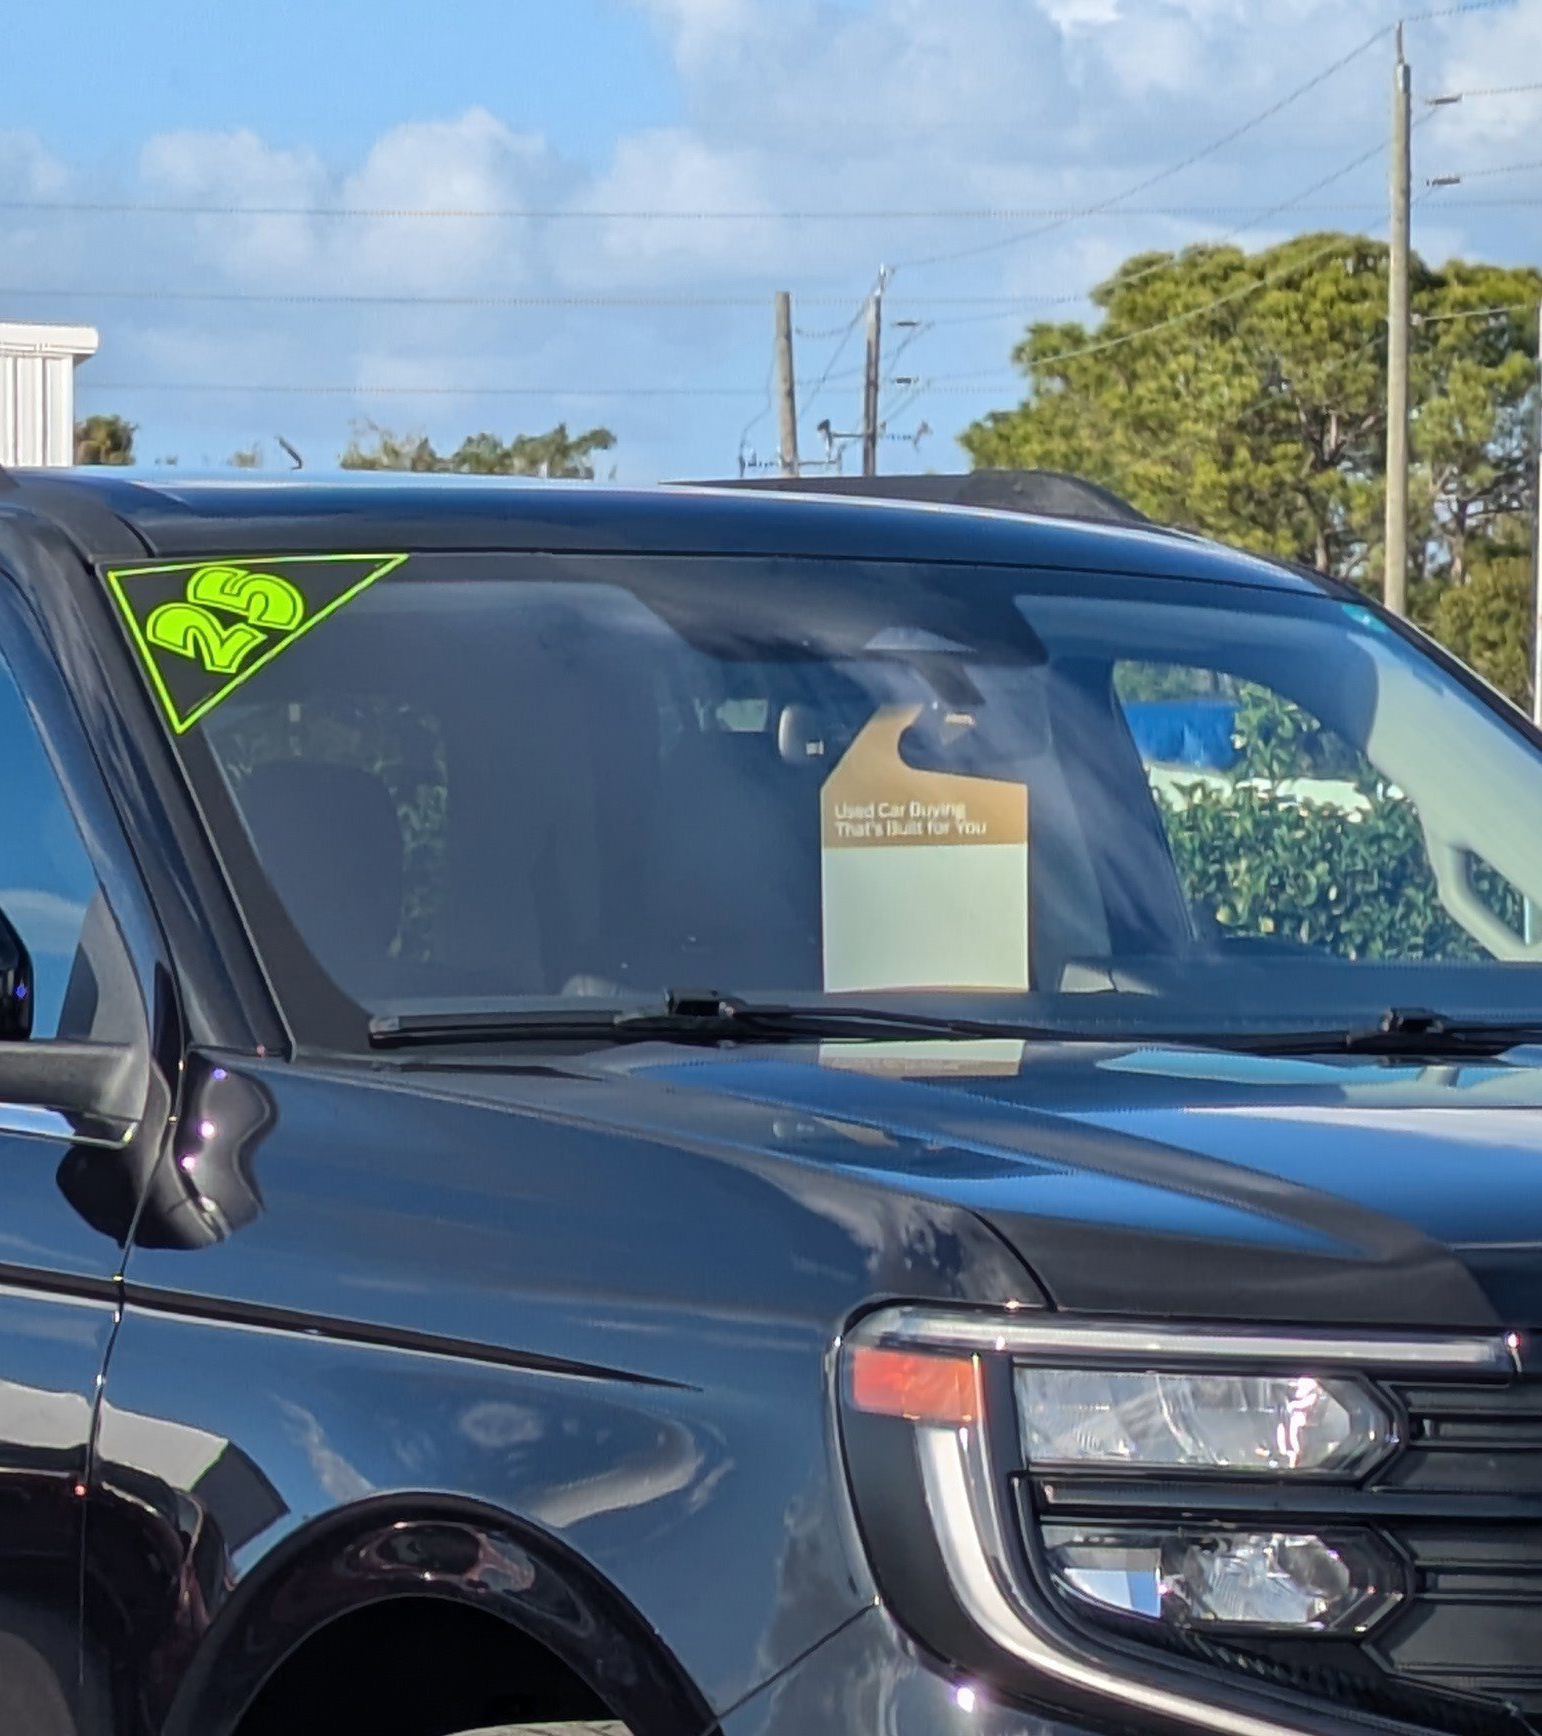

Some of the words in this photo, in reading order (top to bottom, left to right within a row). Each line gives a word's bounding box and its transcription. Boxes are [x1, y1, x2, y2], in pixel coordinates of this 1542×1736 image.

[146, 565, 304, 674] 25
[834, 801, 875, 819] Used
[878, 801, 906, 818] Car
[909, 800, 967, 821] Buying
[835, 819, 884, 837] That's
[886, 819, 923, 836] Built
[927, 819, 951, 836] for
[956, 819, 988, 836] You
